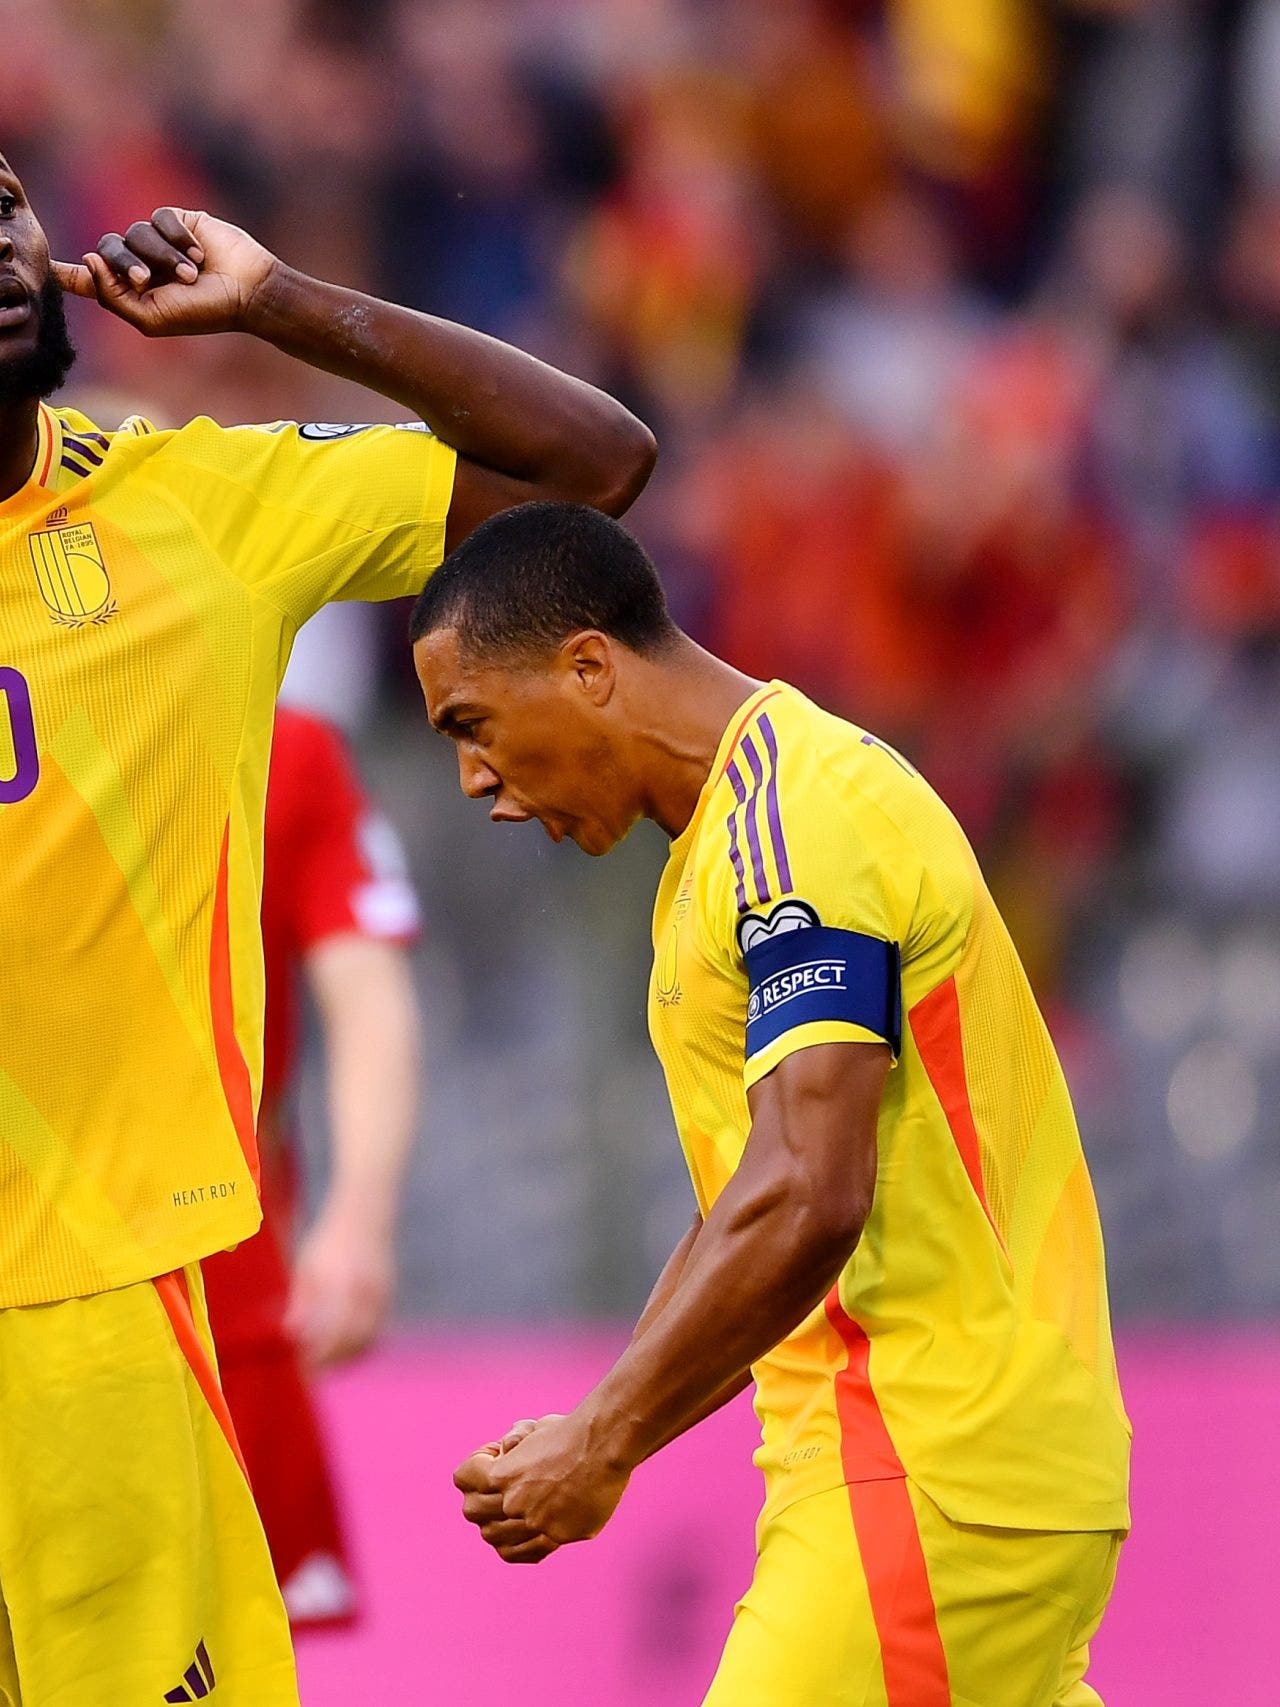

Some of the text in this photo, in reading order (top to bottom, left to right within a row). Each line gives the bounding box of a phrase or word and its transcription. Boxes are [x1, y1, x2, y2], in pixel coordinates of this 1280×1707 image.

[62, 529, 82, 538] ROYAL
[64, 534, 92, 544] BELGIAN
[763, 966, 846, 1007] RESPECT
